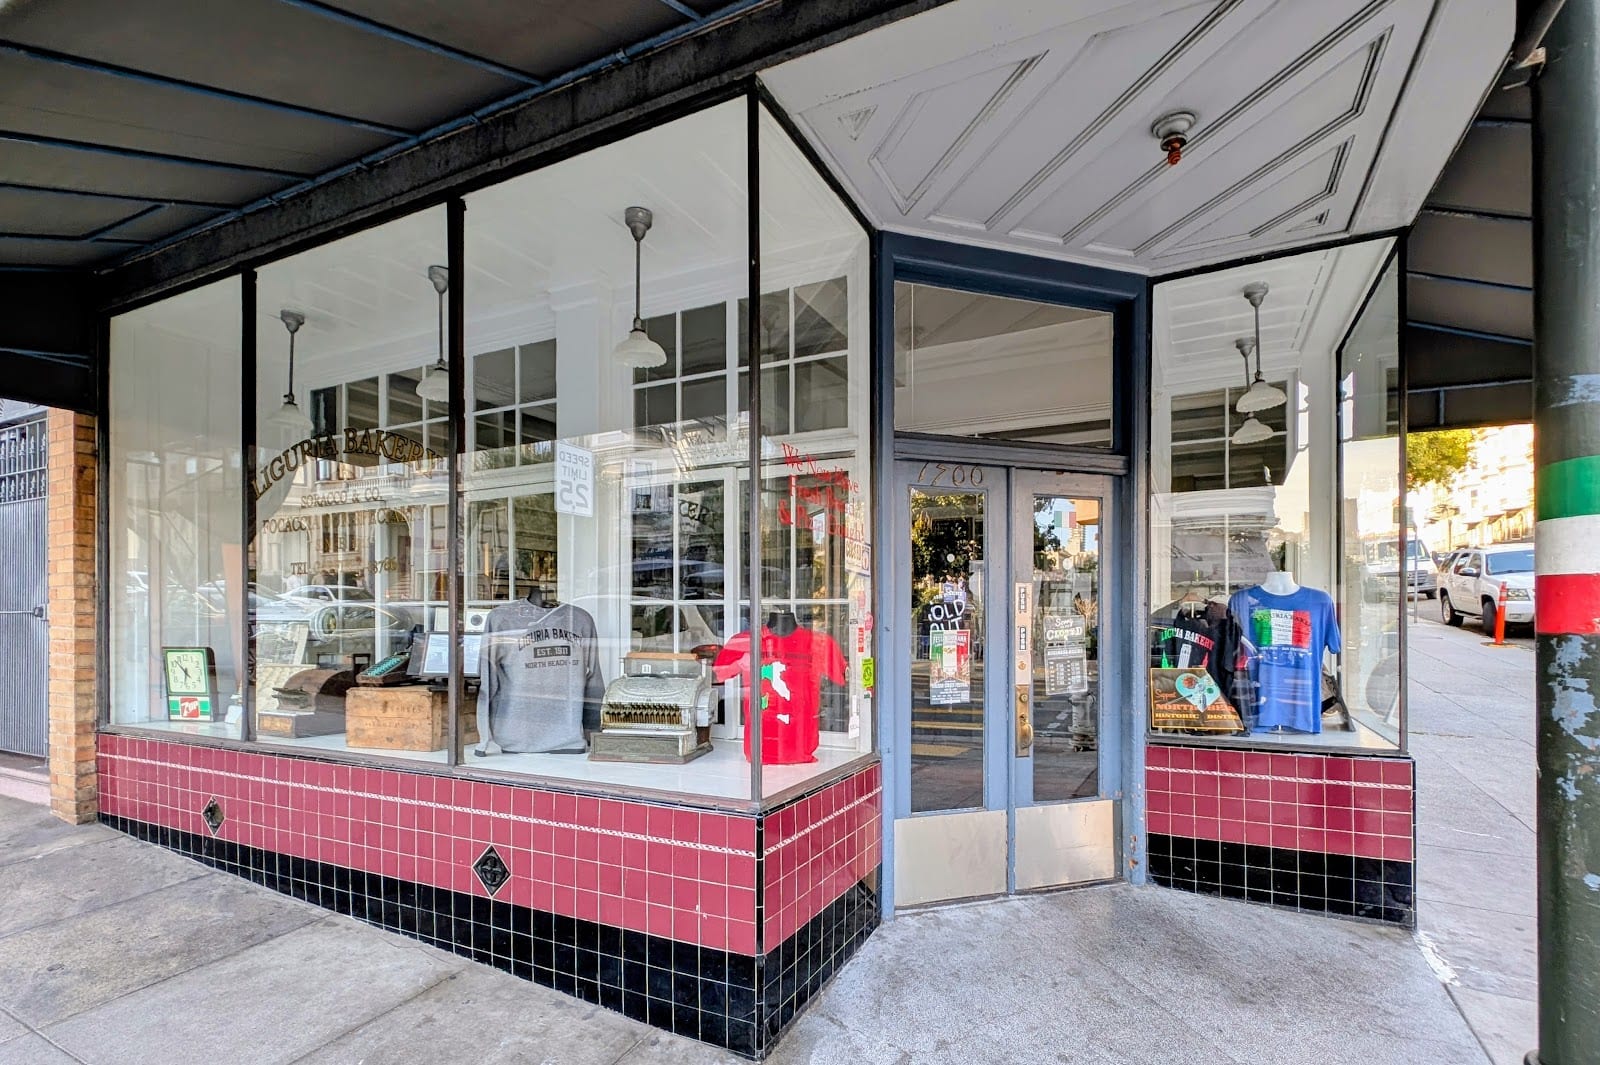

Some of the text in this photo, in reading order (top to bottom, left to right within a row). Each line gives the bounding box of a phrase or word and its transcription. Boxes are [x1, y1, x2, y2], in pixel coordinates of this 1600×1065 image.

[251, 427, 444, 500] LIGURIA BAKERY
[782, 442, 803, 472] We
[300, 487, 383, 509] SORACCO & CO.
[788, 473, 822, 505] Fresh
[778, 499, 794, 526] &
[517, 627, 583, 652] LIGURIA BAKERY
[555, 646, 569, 656] 1911
[1184, 629, 1216, 651] BAKERY
[524, 661, 547, 669] NORTH
[547, 659, 568, 668] BEACH
